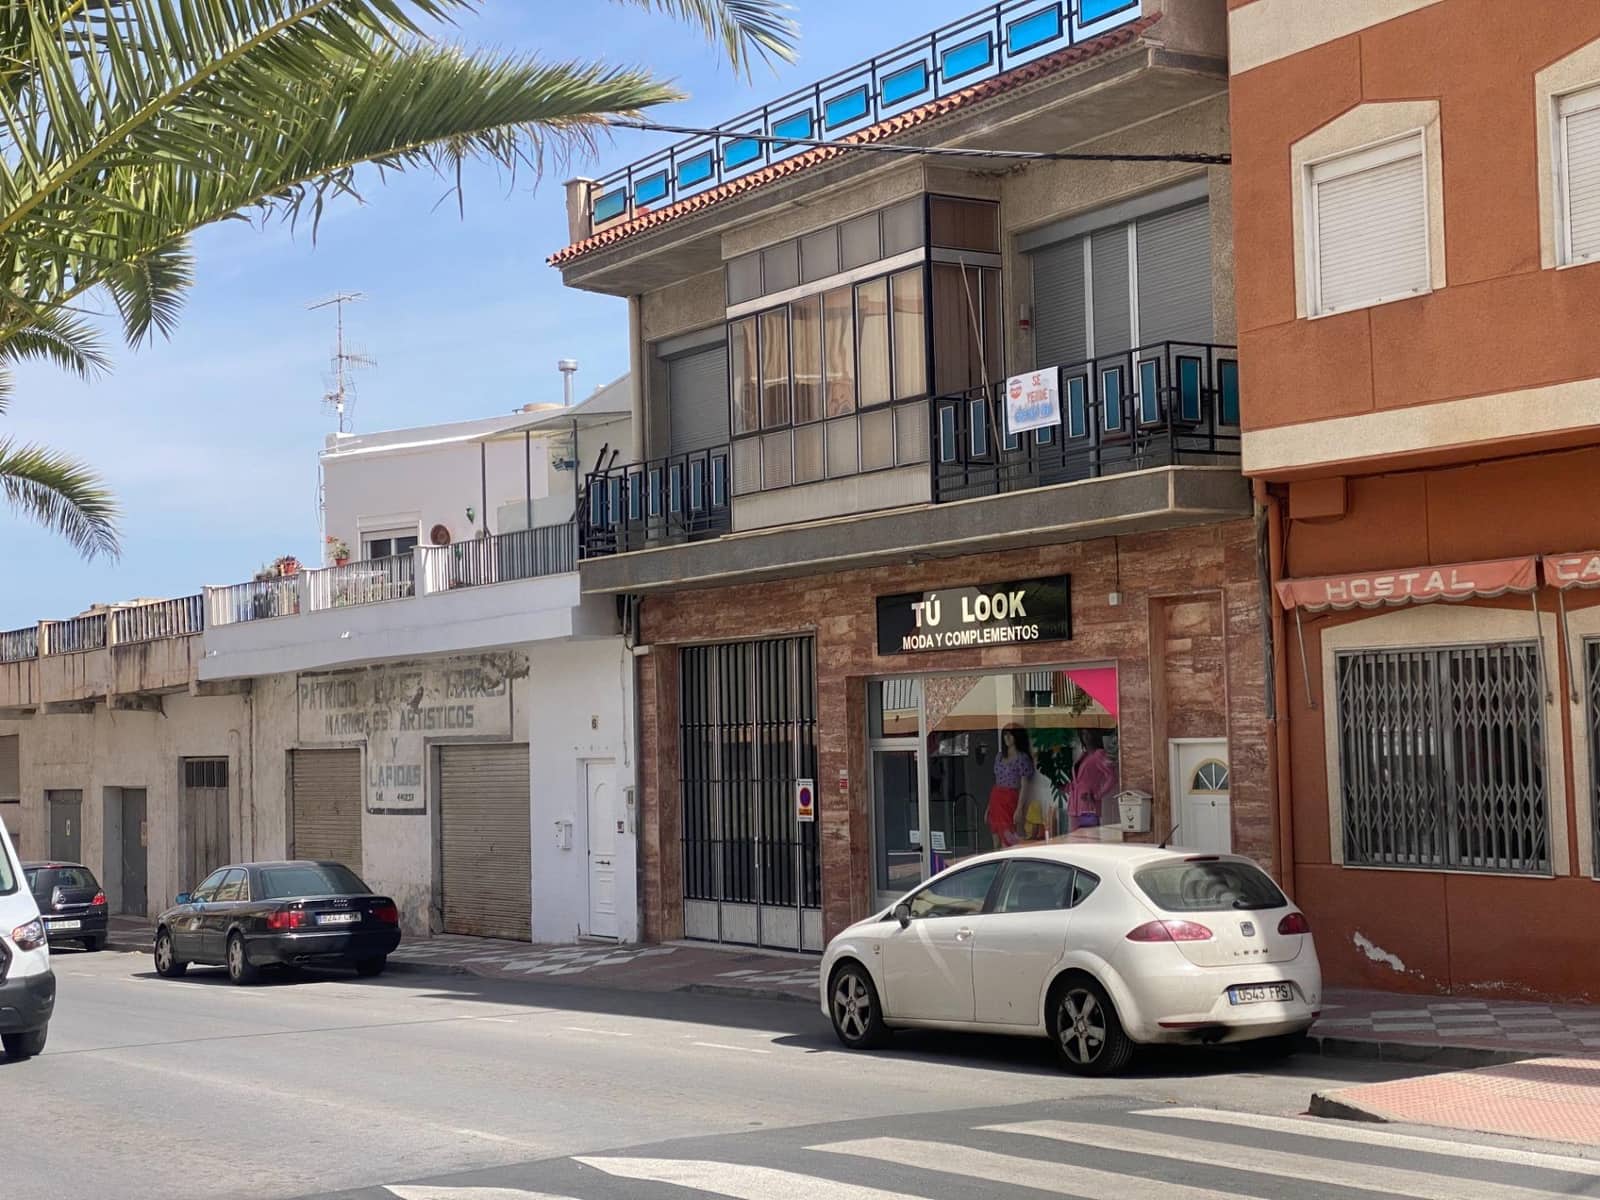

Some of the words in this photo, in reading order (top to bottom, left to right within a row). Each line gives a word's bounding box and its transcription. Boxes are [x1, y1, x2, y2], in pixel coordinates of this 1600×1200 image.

[1325, 569, 1475, 600] HOSTAL
[911, 594, 941, 627] TÚ
[961, 590, 1027, 623] LOOK
[902, 634, 934, 650] MODA
[935, 633, 943, 646] Y
[945, 624, 1039, 646] COMPLEMENTOS
[325, 711, 388, 736] MARMOES
[400, 704, 474, 732] ARTISTICOS
[1269, 985, 1288, 999] FPS
